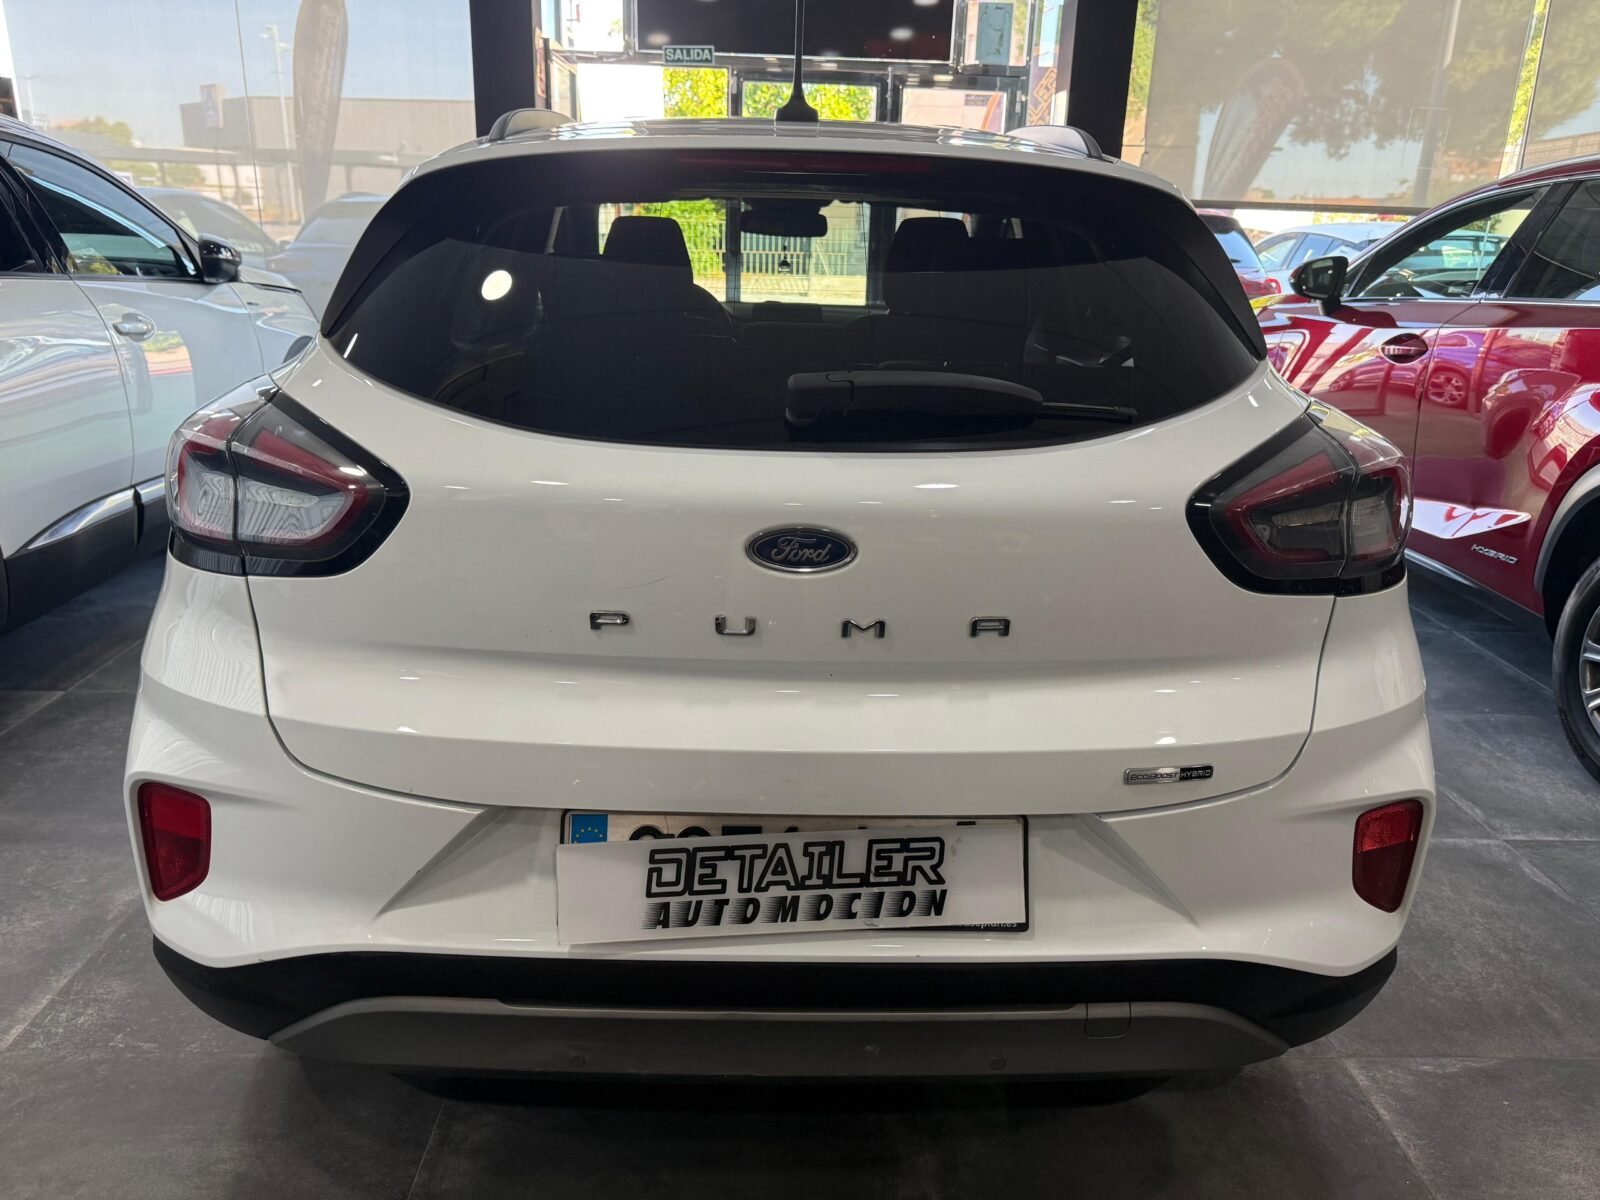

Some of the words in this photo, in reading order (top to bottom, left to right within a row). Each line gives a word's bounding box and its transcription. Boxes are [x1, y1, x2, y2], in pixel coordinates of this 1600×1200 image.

[665, 48, 711, 60] SALIDA
[771, 536, 832, 560] Ford
[1471, 544, 1518, 564] HYBRID
[590, 610, 1011, 638] PUMA
[1181, 769, 1211, 778] HYBRID
[646, 836, 946, 898] DETAILER
[642, 889, 948, 930] AUTOMOCION
